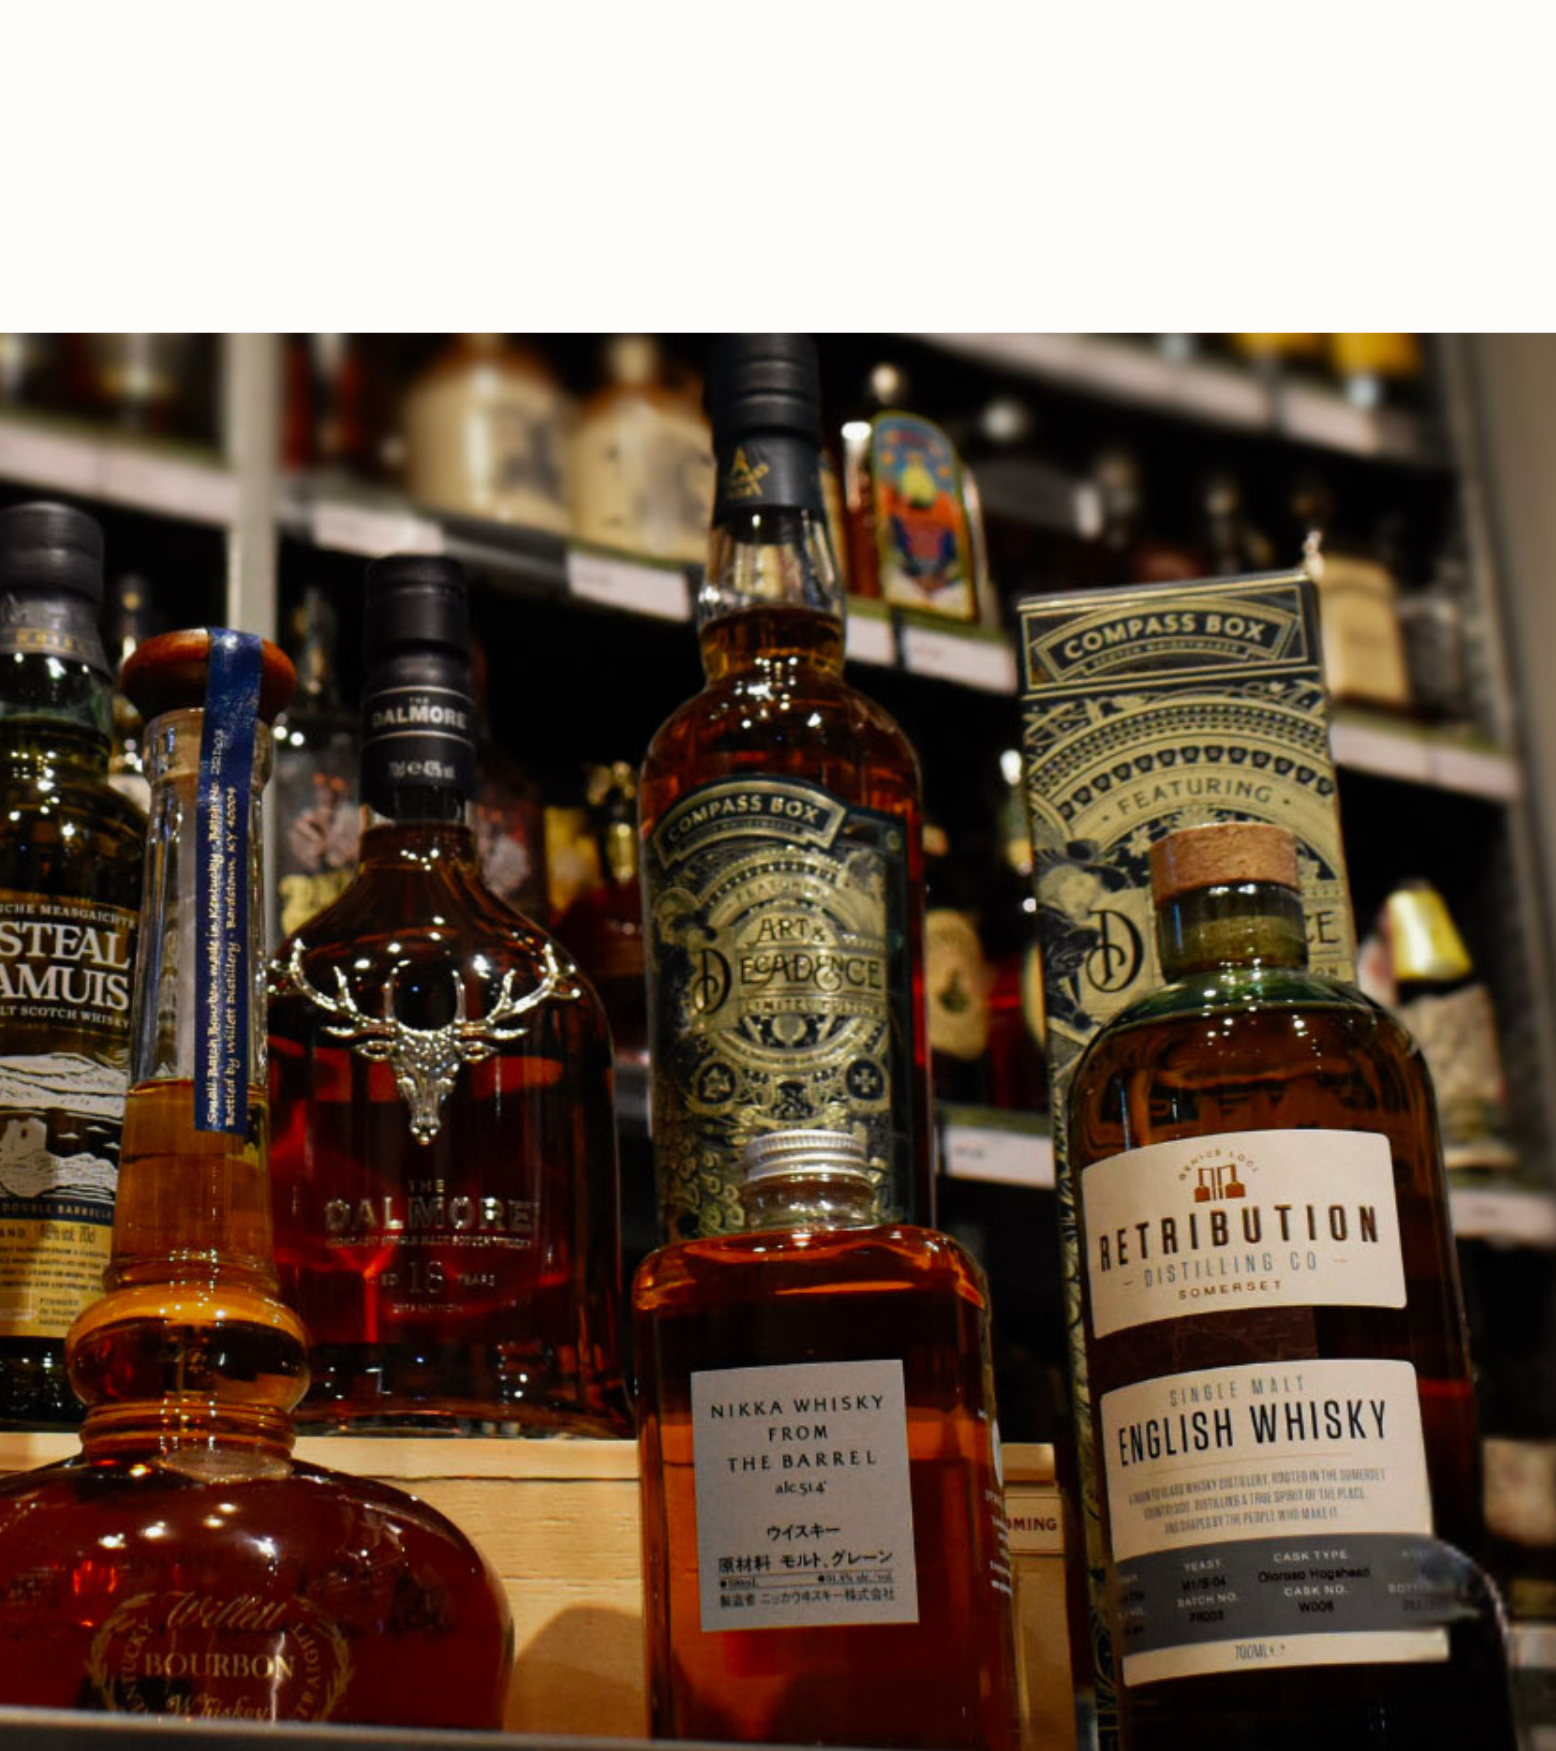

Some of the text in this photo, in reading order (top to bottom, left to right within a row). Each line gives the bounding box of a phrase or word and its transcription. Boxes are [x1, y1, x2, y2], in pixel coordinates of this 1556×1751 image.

[1063, 612, 1266, 660] COMPASS BOX
[371, 706, 467, 730] DALMORE
[1117, 777, 1275, 816] FEATURING
[667, 794, 820, 843] COMPASS BOX
[206, 940, 220, 976] made
[20, 1005, 78, 1021] SCOTCH
[80, 1010, 130, 1028] WHISKY
[206, 980, 220, 1036] Bourbon
[206, 1040, 221, 1077] Batch
[206, 1082, 220, 1125] Small
[407, 1178, 445, 1194] THE
[57, 1203, 115, 1221] BARRELLE
[325, 1194, 534, 1233] DALMORE
[1099, 1203, 1379, 1273] RETRIBUTION
[1144, 1250, 1318, 1288] DISTILLING CO
[1178, 1279, 1282, 1301] SOMERSET
[1169, 1374, 1304, 1408] SINGLE MALT
[711, 1394, 885, 1420] NIKKA WHISKY
[767, 1424, 829, 1443] FROM
[1117, 1399, 1387, 1469] ENGLISH WHISKY
[727, 1450, 878, 1473] THE BARREL
[1272, 1472, 1308, 1484] ROOTED
[1309, 1471, 1319, 1482] IN
[1321, 1470, 1337, 1481] THE
[1273, 1490, 1303, 1503] SPIRIT
[1305, 1489, 1317, 1500] OF
[1319, 1489, 1336, 1501] THE
[1006, 1517, 1057, 1531] OMING
[1302, 1507, 1327, 1519] MAKE
[766, 1523, 841, 1542] ウイスキー
[718, 1556, 771, 1574] 原材料
[1183, 1549, 1348, 1573] YEAST CASK TYPE
[1309, 1565, 1371, 1582] Hogshead
[1176, 1593, 1215, 1608] BATCH
[1282, 1585, 1321, 1598] CASK
[164, 1590, 288, 1630] Willett
[144, 1651, 295, 1680] BOURBON
